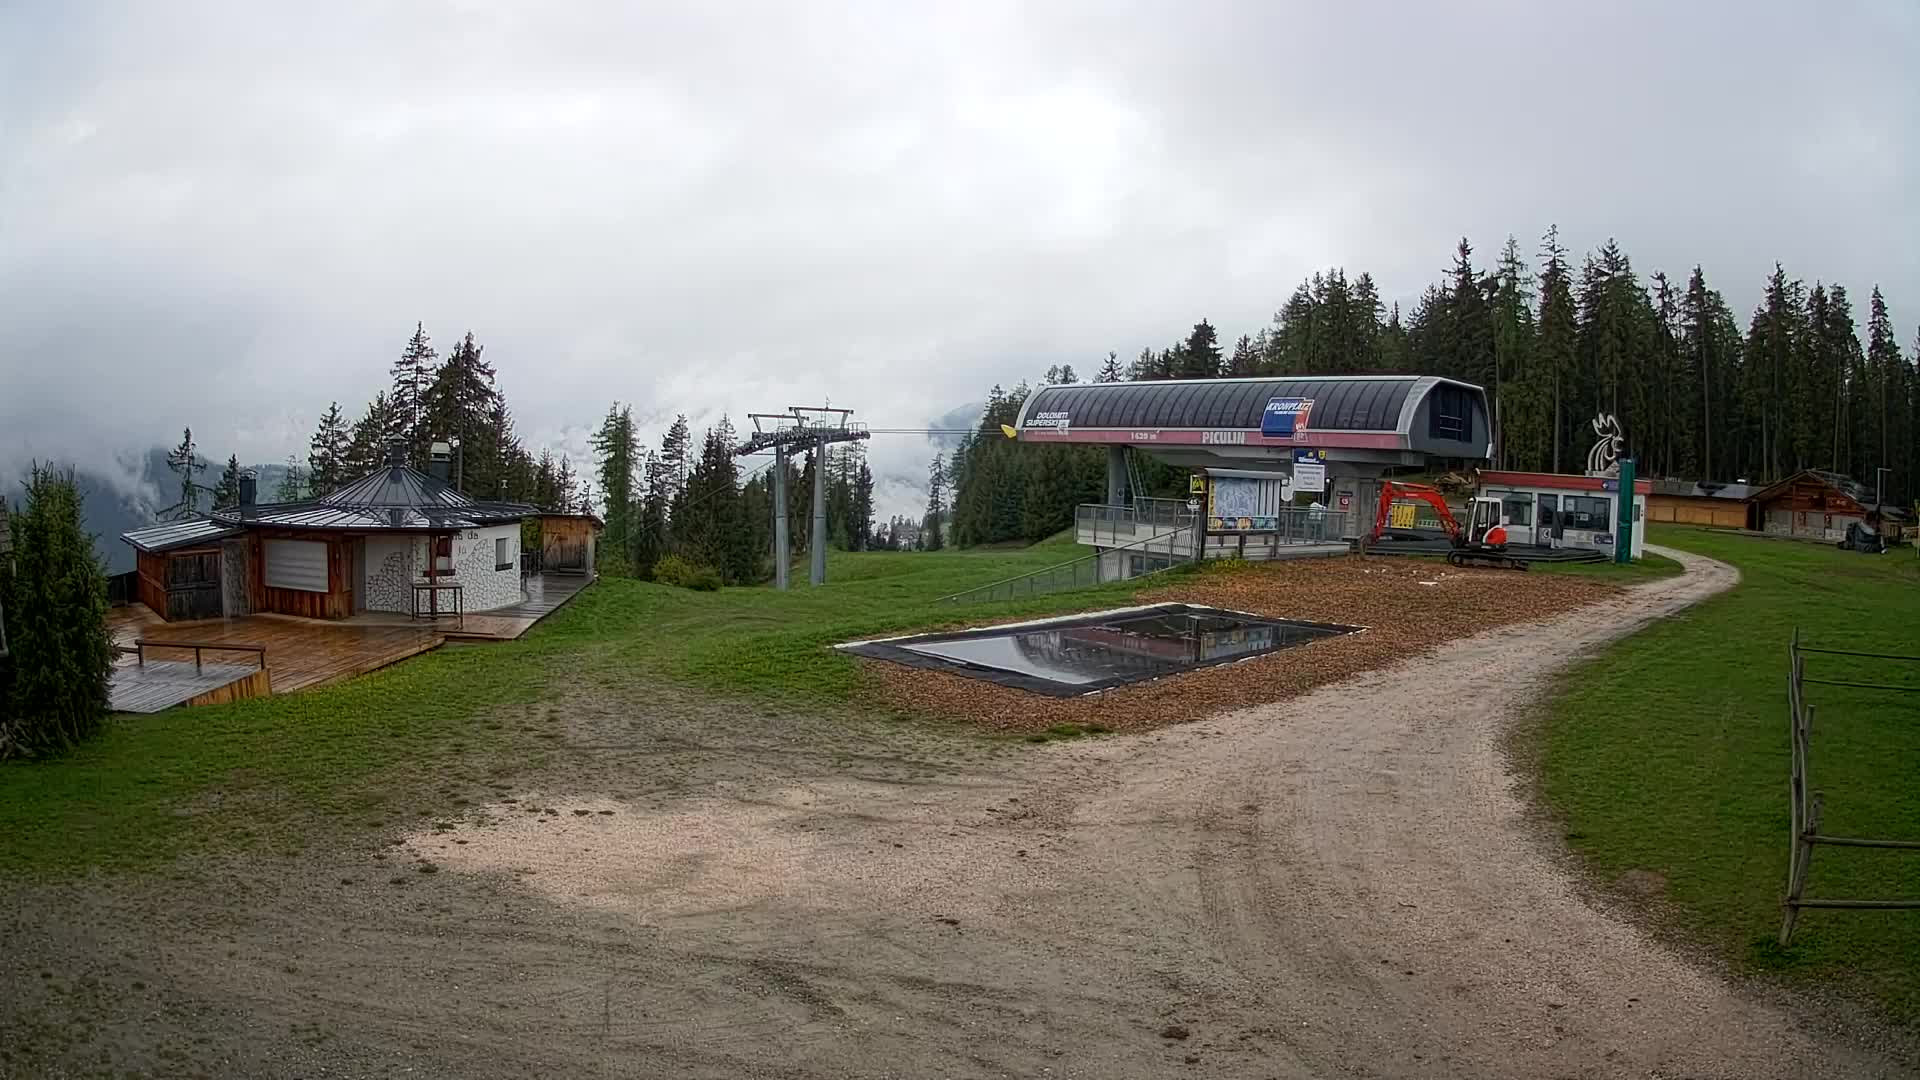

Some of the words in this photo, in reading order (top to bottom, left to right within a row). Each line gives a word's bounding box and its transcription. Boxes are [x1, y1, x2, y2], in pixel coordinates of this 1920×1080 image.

[1265, 402, 1312, 411] KRONPLATZ
[1036, 411, 1069, 419] DOLOMITI
[1025, 419, 1059, 427] SUPERSKI
[1202, 431, 1246, 445] PICULIN
